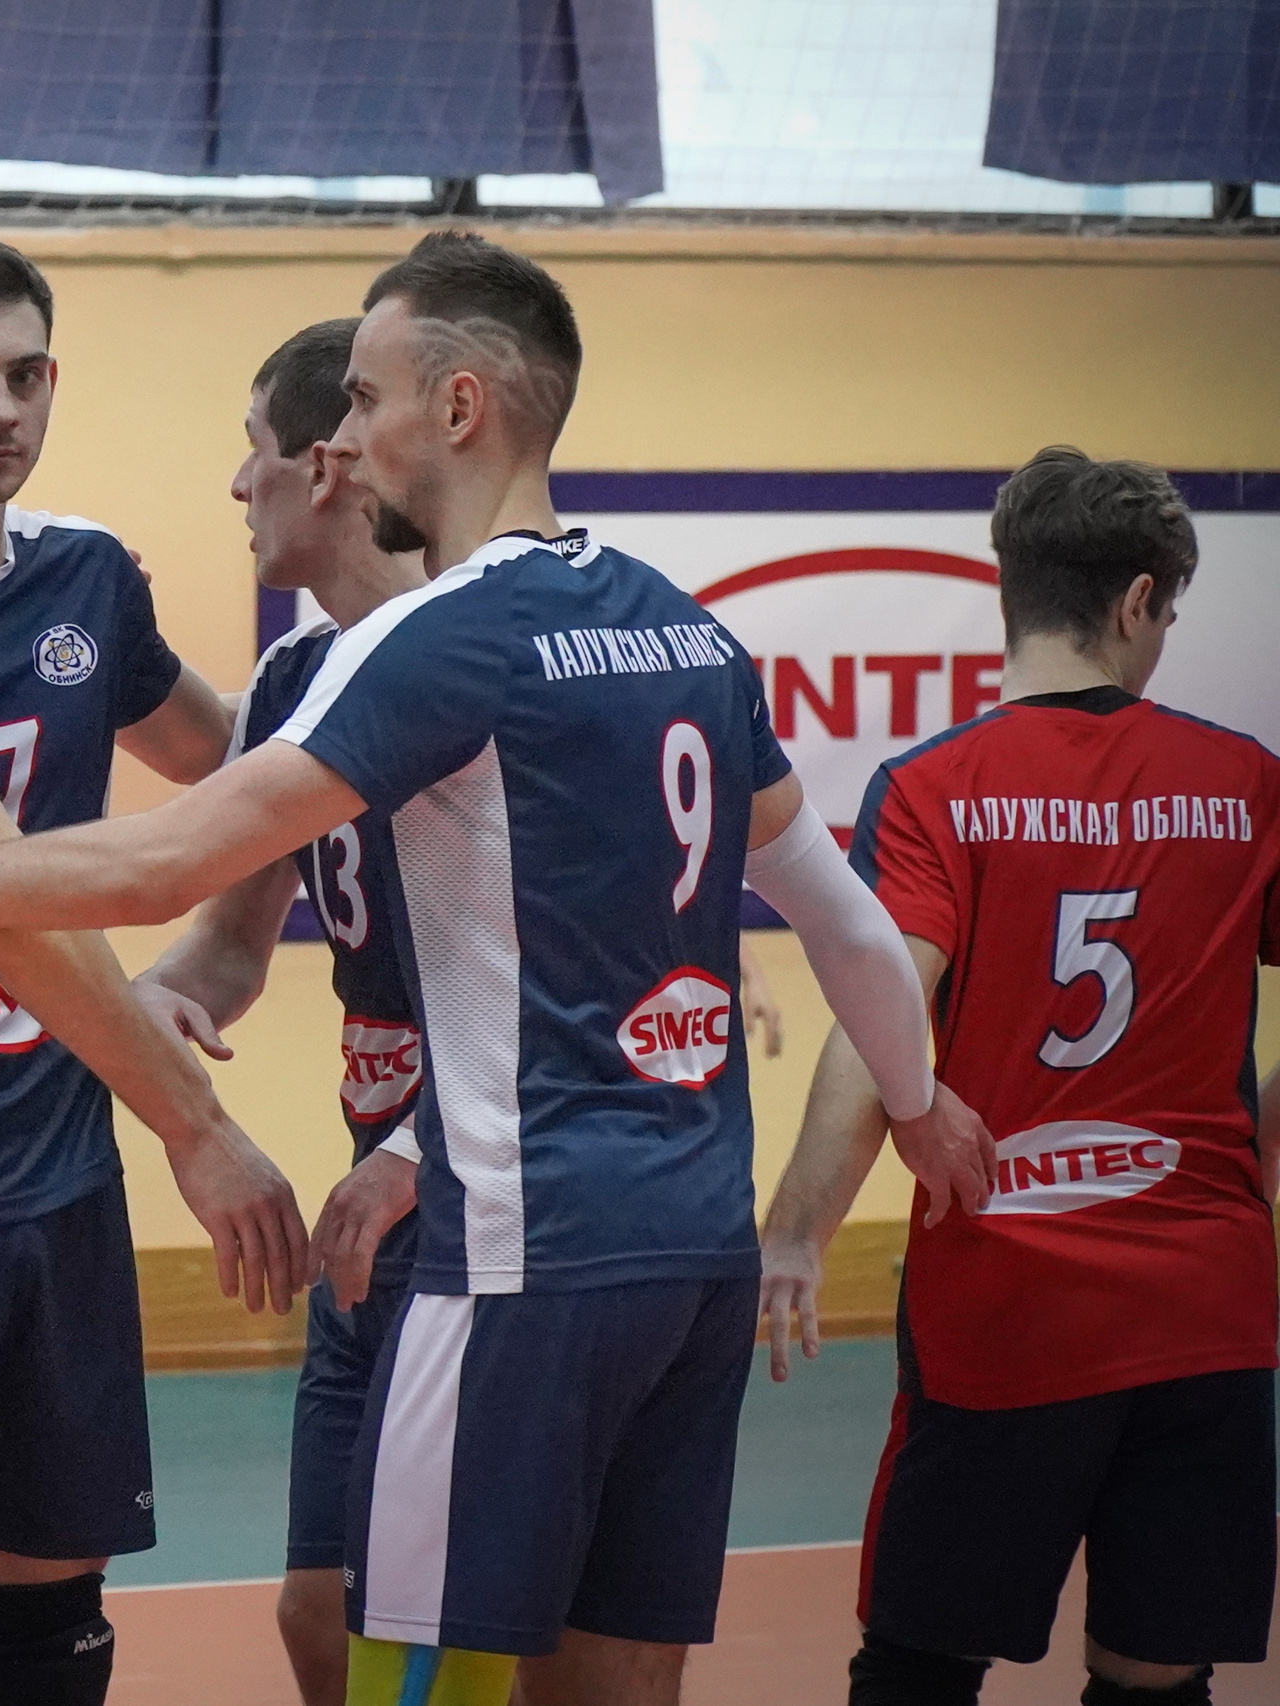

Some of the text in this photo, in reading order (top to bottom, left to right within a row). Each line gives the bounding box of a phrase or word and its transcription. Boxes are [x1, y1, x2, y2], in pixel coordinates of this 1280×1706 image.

[48, 664, 92, 684] ОБНИНСК
[532, 627, 672, 681] КАЛУЖСКАЯ
[754, 655, 1006, 738] NTE
[662, 721, 713, 915] 9
[950, 794, 1253, 846] КАЛУЖСКАЯ ОБЛАСТЬ
[1038, 890, 1139, 1070] 5
[990, 1139, 1165, 1196] INTEC
[73, 1628, 113, 1655] MIKAS
